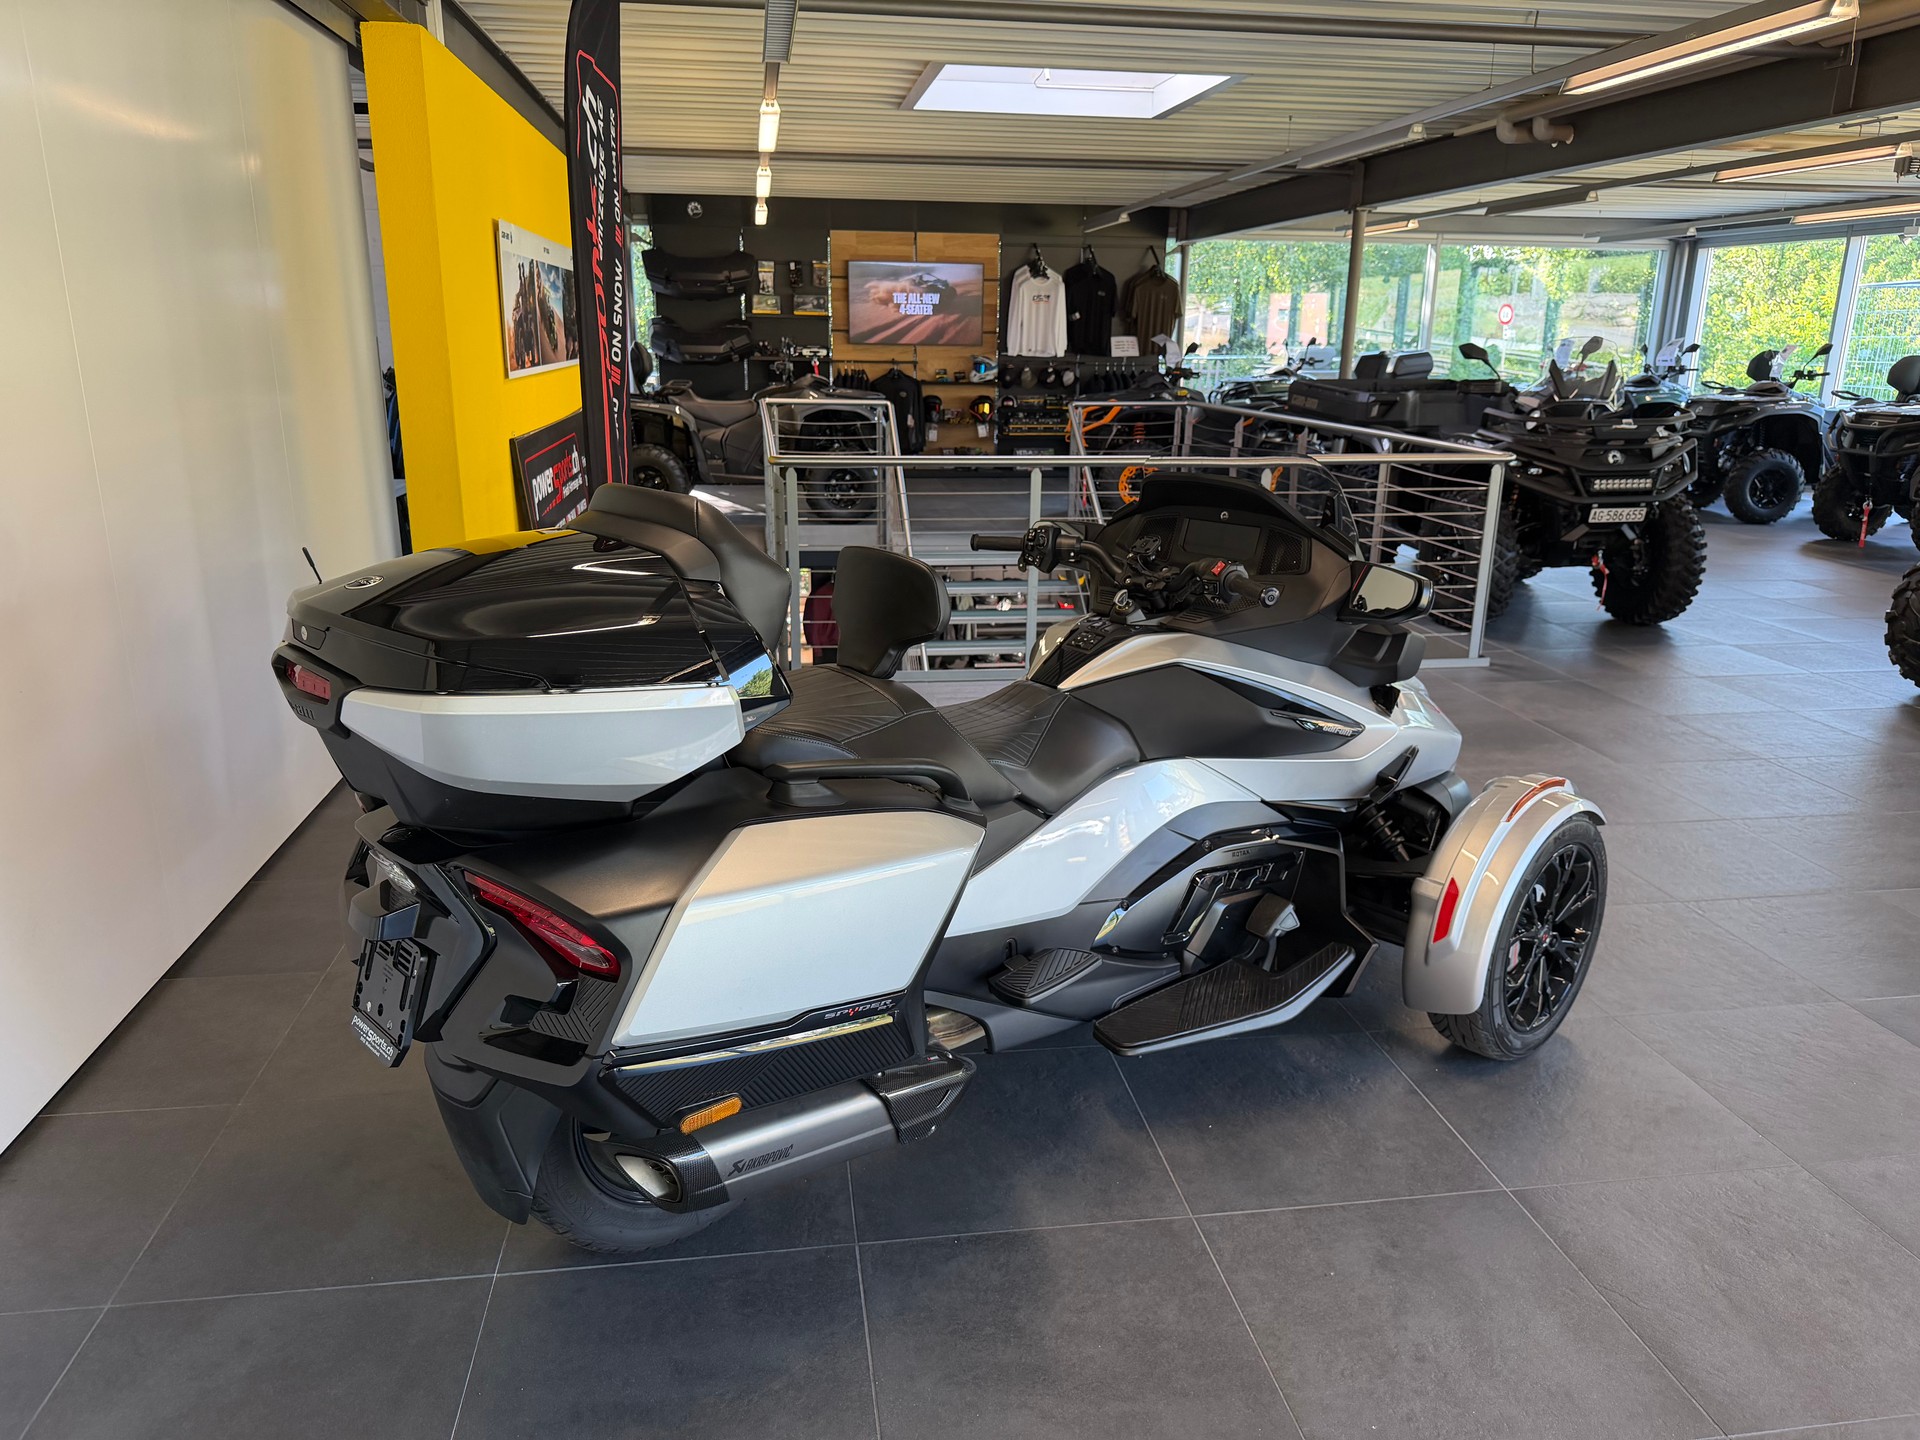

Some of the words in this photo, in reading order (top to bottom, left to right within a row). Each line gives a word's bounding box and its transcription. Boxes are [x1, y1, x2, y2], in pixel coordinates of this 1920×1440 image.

[613, 190, 622, 224] ON
[613, 257, 624, 328] SNOW
[892, 292, 907, 304] THE
[908, 292, 940, 304] ALL-NEW
[899, 304, 934, 315] 4-SEATER
[611, 331, 623, 363] ON
[824, 999, 892, 1020] SPYDER
